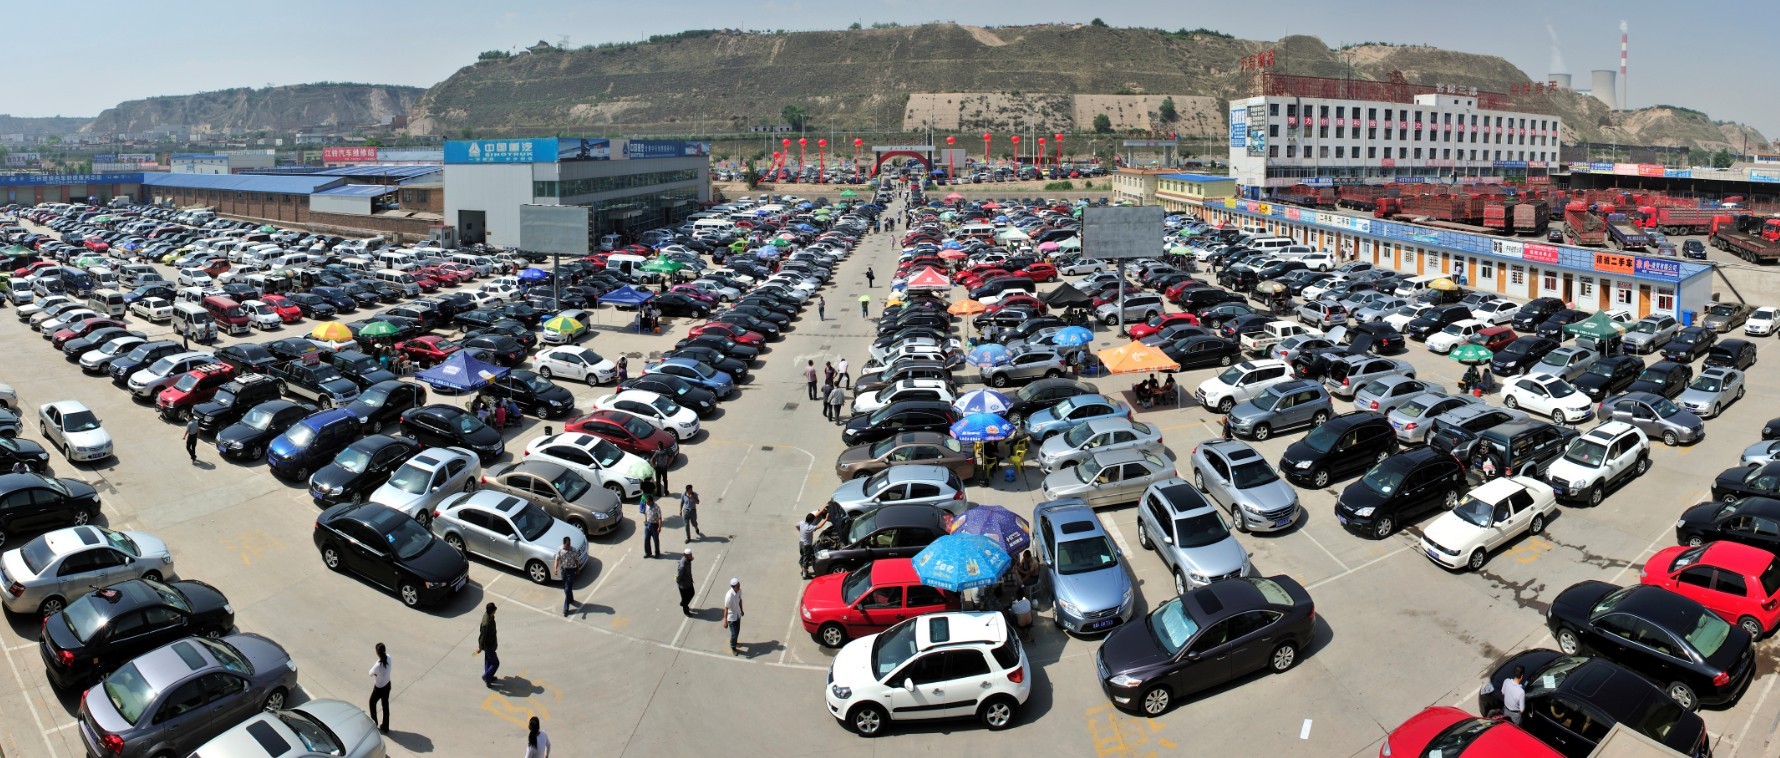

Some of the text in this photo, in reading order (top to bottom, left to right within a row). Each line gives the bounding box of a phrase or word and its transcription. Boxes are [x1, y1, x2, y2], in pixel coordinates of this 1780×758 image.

[484, 142, 533, 152] 中国重汽
[324, 148, 375, 157] 江铃汽车维修站
